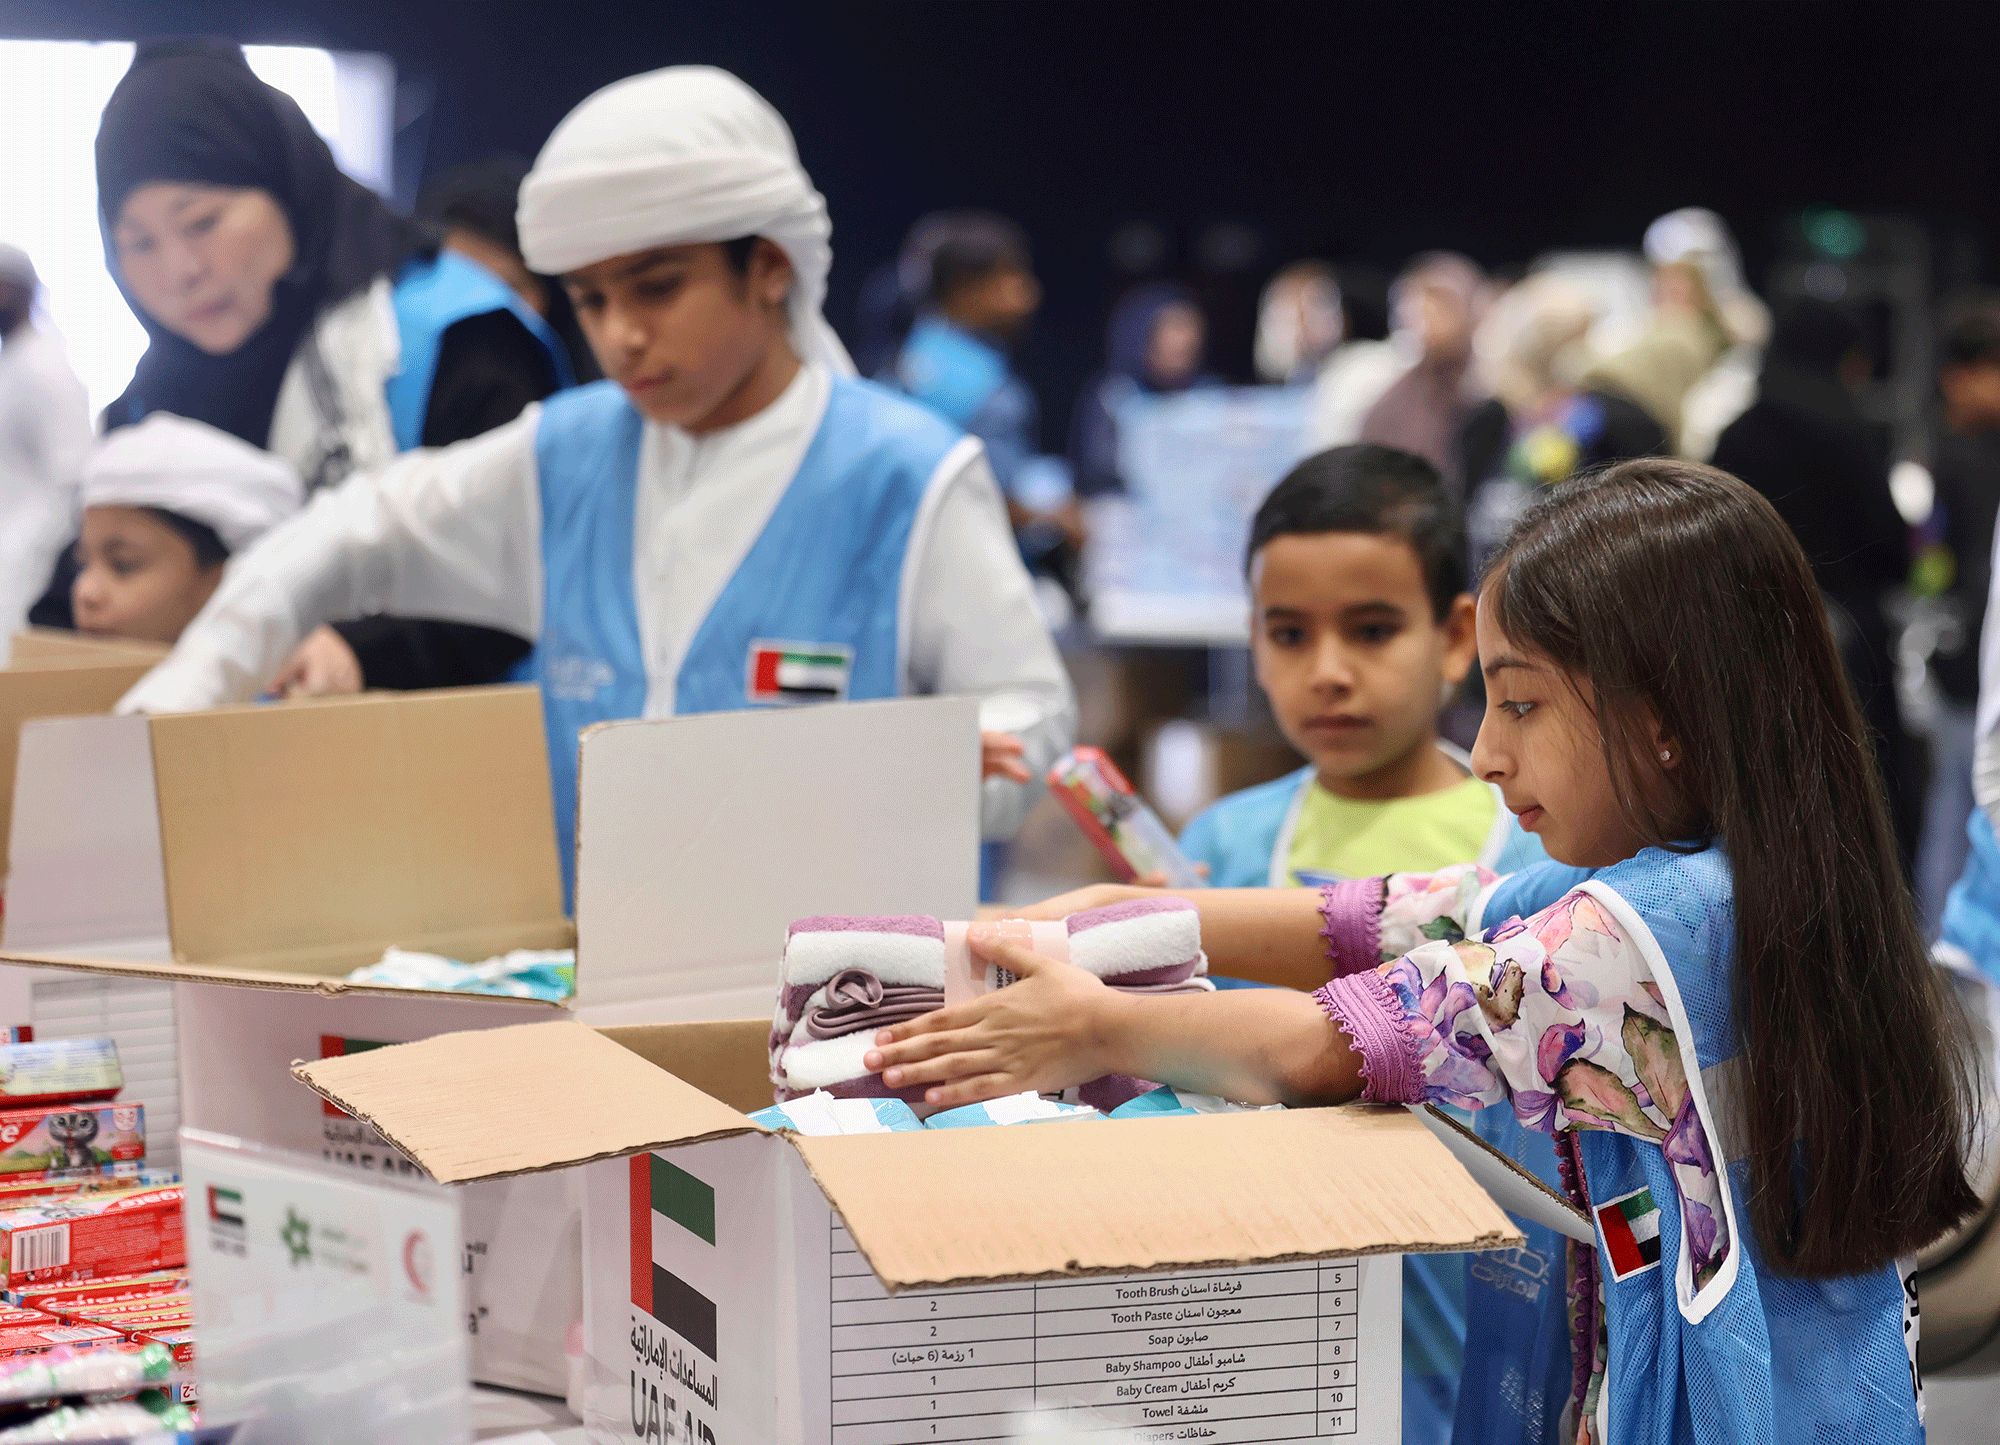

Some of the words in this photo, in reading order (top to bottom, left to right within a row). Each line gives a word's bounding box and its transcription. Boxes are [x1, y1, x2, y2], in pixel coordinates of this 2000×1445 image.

[1334, 1273, 1342, 1284] 5
[1116, 1286, 1148, 1300] Tooth
[1149, 1286, 1179, 1298] Brush
[1181, 1283, 1211, 1298] اسنان
[1212, 1280, 1242, 1295] فرشاة
[930, 1301, 937, 1312] 2
[1334, 1297, 1341, 1307] 6
[1111, 1311, 1142, 1324] Tooth
[1145, 1311, 1173, 1323] Paste
[1175, 1307, 1205, 1322] اسنان
[1206, 1307, 1242, 1320] معجون
[930, 1326, 937, 1337] 2
[1334, 1321, 1341, 1331] 7
[1148, 1334, 1174, 1348] Soap
[1176, 1332, 1209, 1347] صابون
[631, 1315, 668, 1381] الإماراتية
[969, 1347, 974, 1358] 1
[1334, 1345, 1341, 1356] 8
[941, 1350, 965, 1362] رزمة
[1184, 1353, 1214, 1369] أطفال
[1215, 1352, 1246, 1367] شامبو
[1105, 1361, 1131, 1375] Baby
[1133, 1359, 1182, 1373] Shampoo
[669, 1348, 717, 1411] المساعدات
[930, 1375, 936, 1386] 1
[1333, 1369, 1340, 1380] 9
[1180, 1378, 1211, 1394] أطفال
[1212, 1376, 1236, 1392] كريم
[1116, 1384, 1142, 1399] Baby
[1144, 1383, 1178, 1395] Cream
[1330, 1392, 1344, 1403] 10
[930, 1400, 936, 1410] 1
[1177, 1404, 1209, 1415] منشفة
[1142, 1405, 1174, 1419] Towel
[1330, 1416, 1343, 1427] 11
[930, 1424, 936, 1435] 1
[1177, 1426, 1217, 1439] حفاظات
